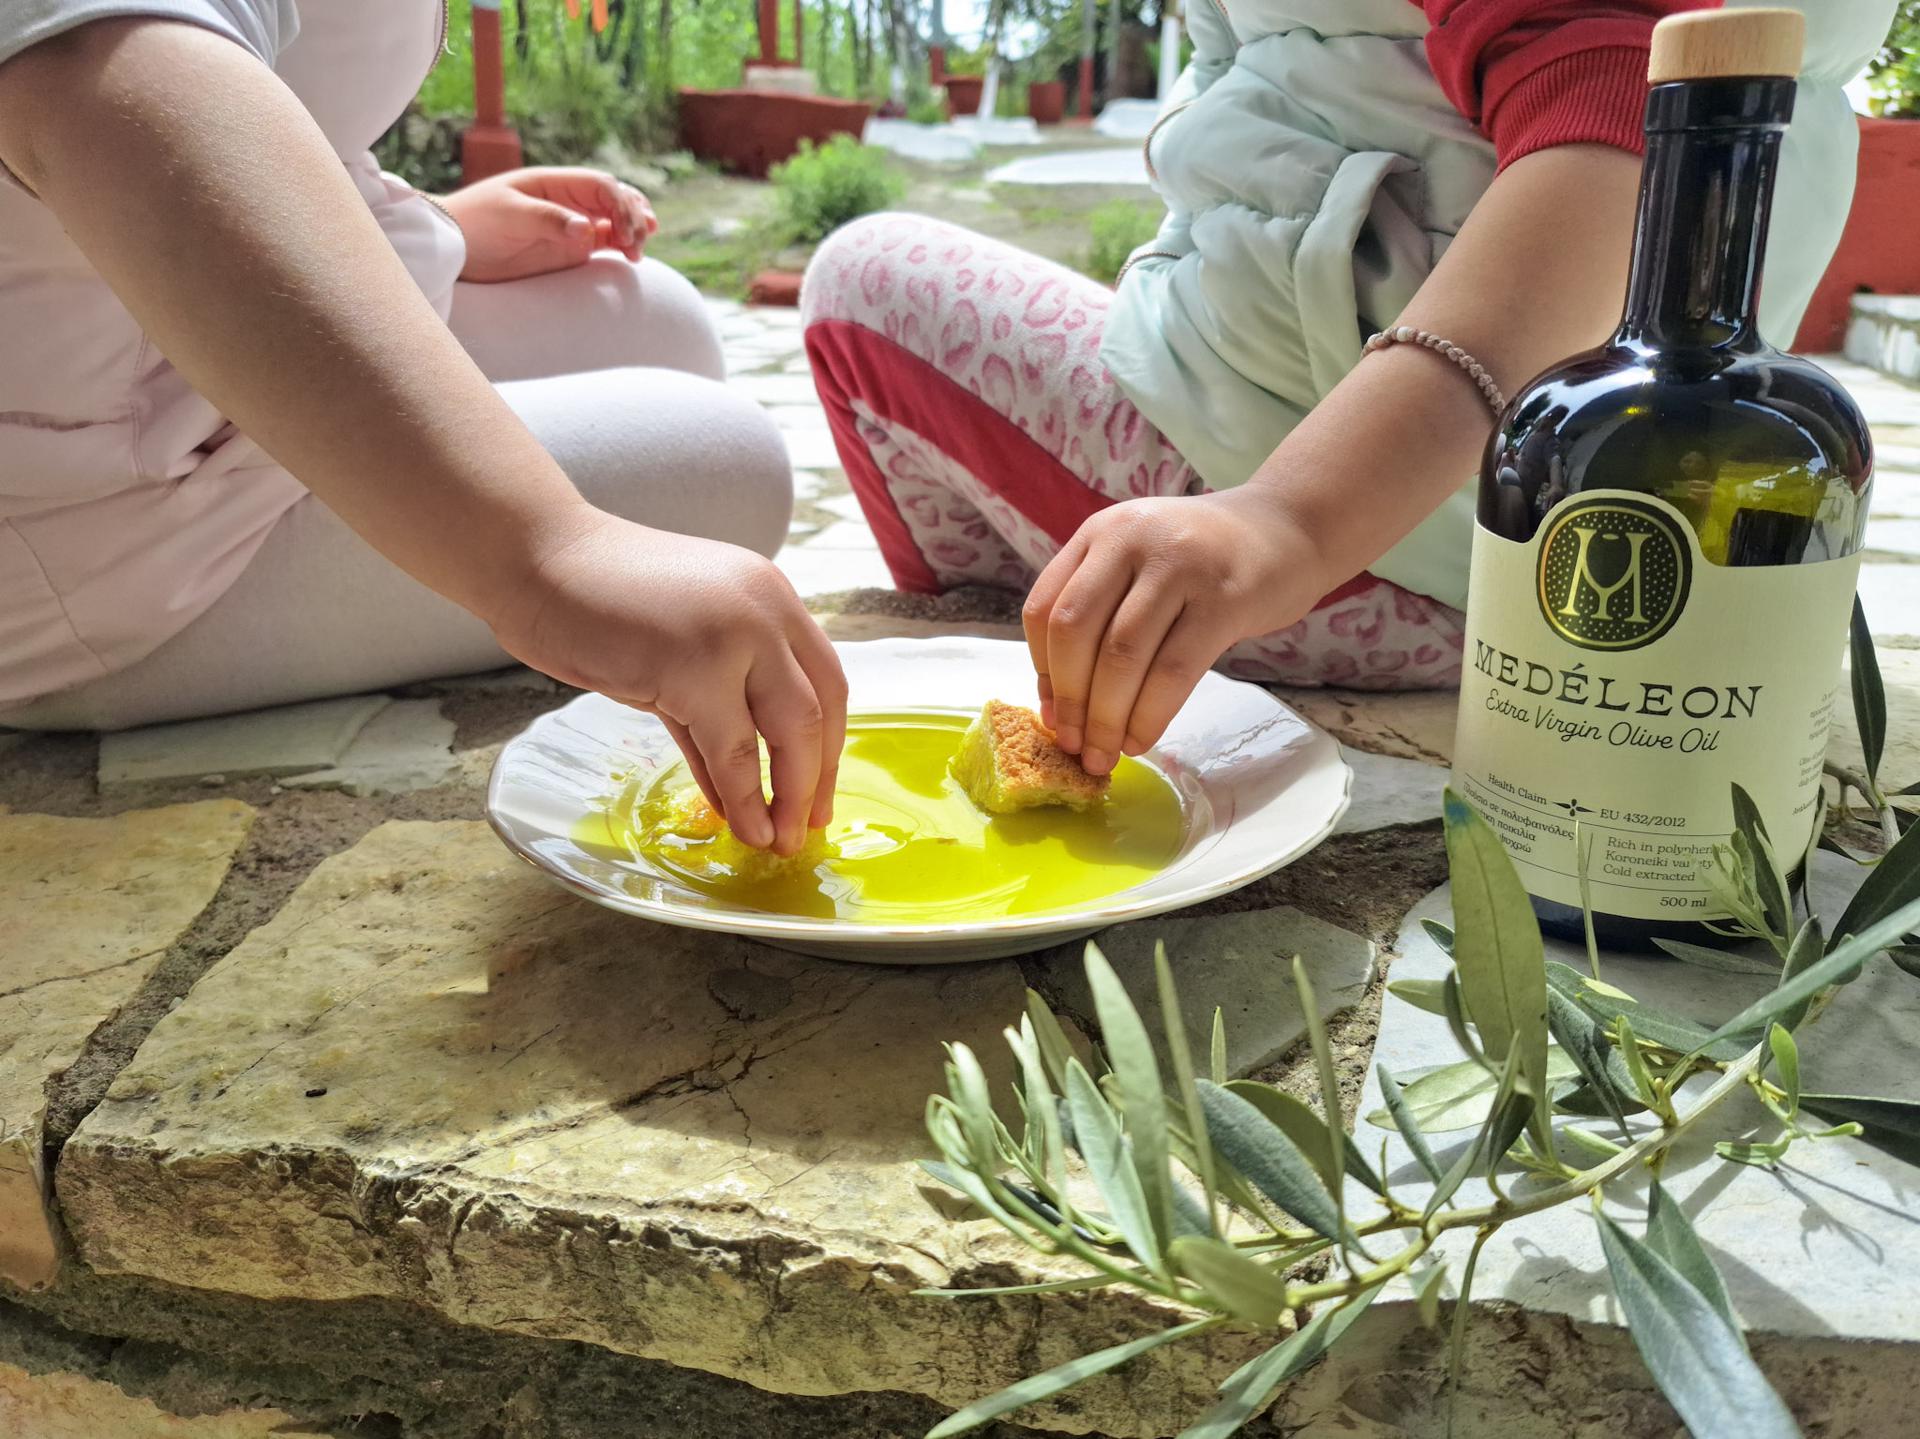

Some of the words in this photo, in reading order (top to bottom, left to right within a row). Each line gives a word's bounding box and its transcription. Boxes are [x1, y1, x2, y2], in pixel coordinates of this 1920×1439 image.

[1474, 638, 1763, 719] MEDÉLEON
[1485, 689, 1530, 723] Extra
[1534, 704, 1602, 743] Virgin
[1608, 721, 1673, 749] Olive
[1680, 728, 1720, 754] Oil
[1488, 773, 1515, 794] Health
[1518, 787, 1547, 805] Claim
[1600, 808, 1620, 820] EU
[1623, 812, 1686, 827] 432/2012
[1501, 808, 1575, 841] πολυφαινόλες
[1608, 836, 1636, 850] Rich
[1640, 842, 1653, 852] in
[1606, 850, 1667, 867] Koroneiki
[1603, 864, 1632, 877] Cold
[1636, 871, 1695, 882] extracted
[1660, 896, 1688, 907] 500
[1691, 897, 1707, 907] ml
